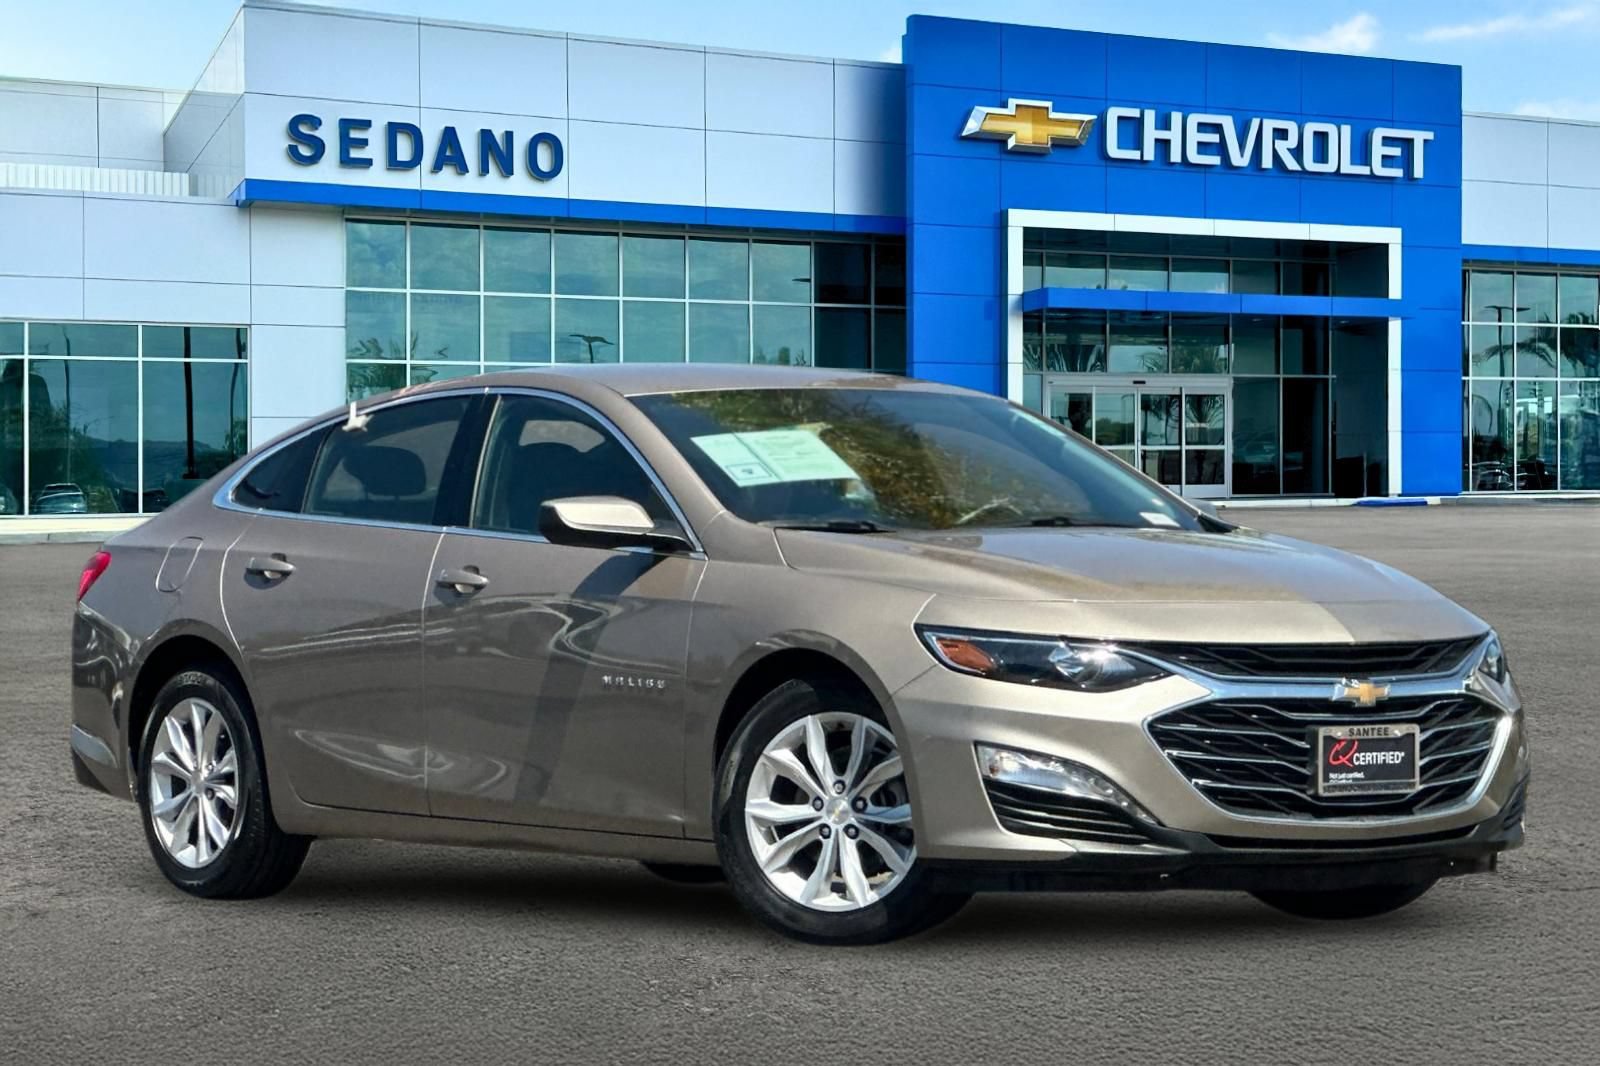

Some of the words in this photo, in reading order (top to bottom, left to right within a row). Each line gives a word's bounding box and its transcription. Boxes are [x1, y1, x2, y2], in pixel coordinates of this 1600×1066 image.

[286, 113, 564, 182] SEDANO
[1105, 106, 1435, 179] CHEVROLET
[1348, 726, 1390, 737] SANTEE
